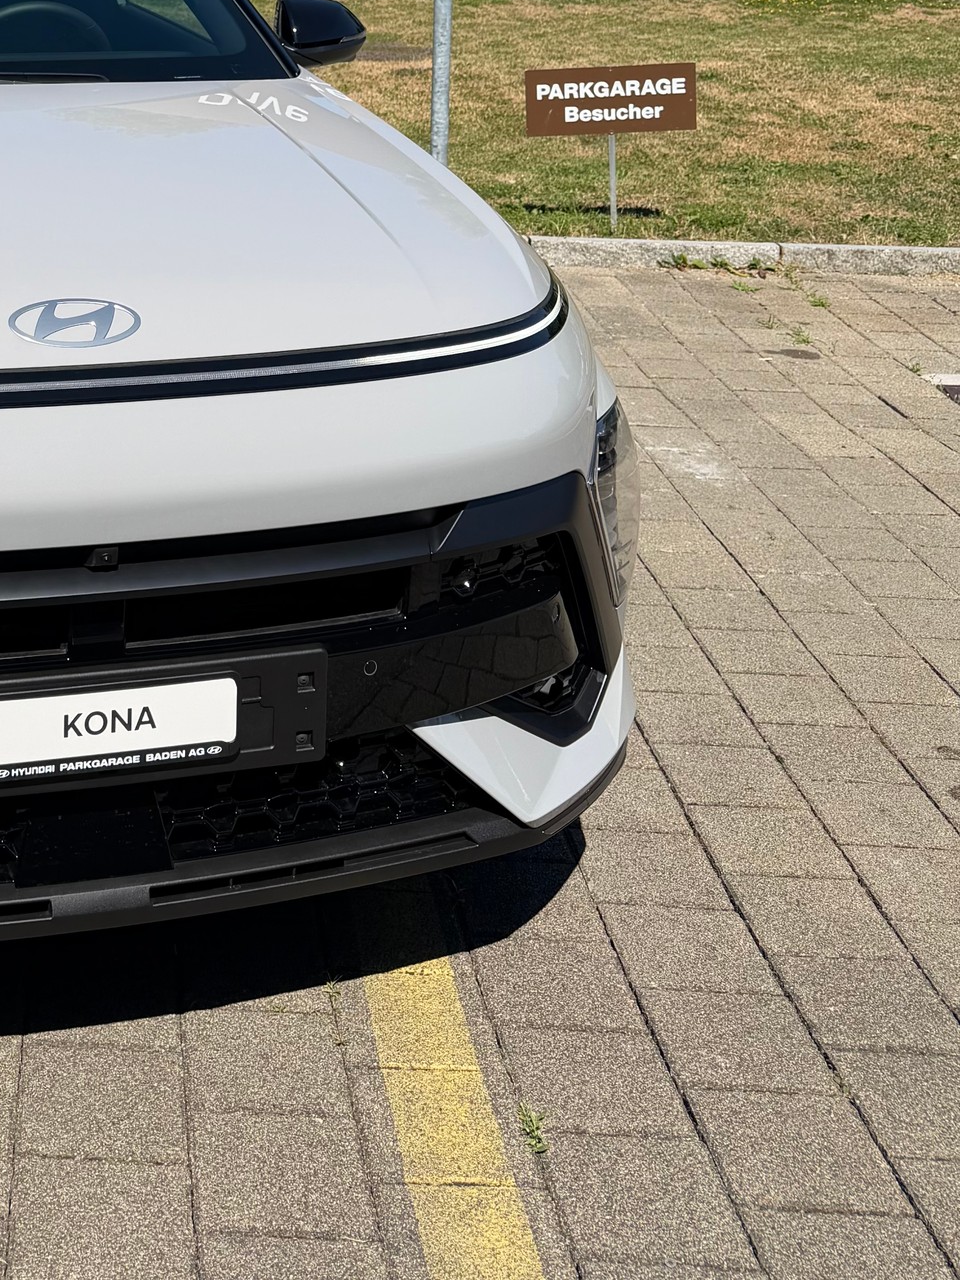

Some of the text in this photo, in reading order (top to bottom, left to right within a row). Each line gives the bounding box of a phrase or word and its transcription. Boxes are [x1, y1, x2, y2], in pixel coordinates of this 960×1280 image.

[536, 77, 686, 101] PARKGARAGE
[564, 103, 664, 123] Besucher
[63, 706, 157, 738] KONA
[11, 747, 205, 777] HYUNDAI PARKGARAGE BADEN AG
